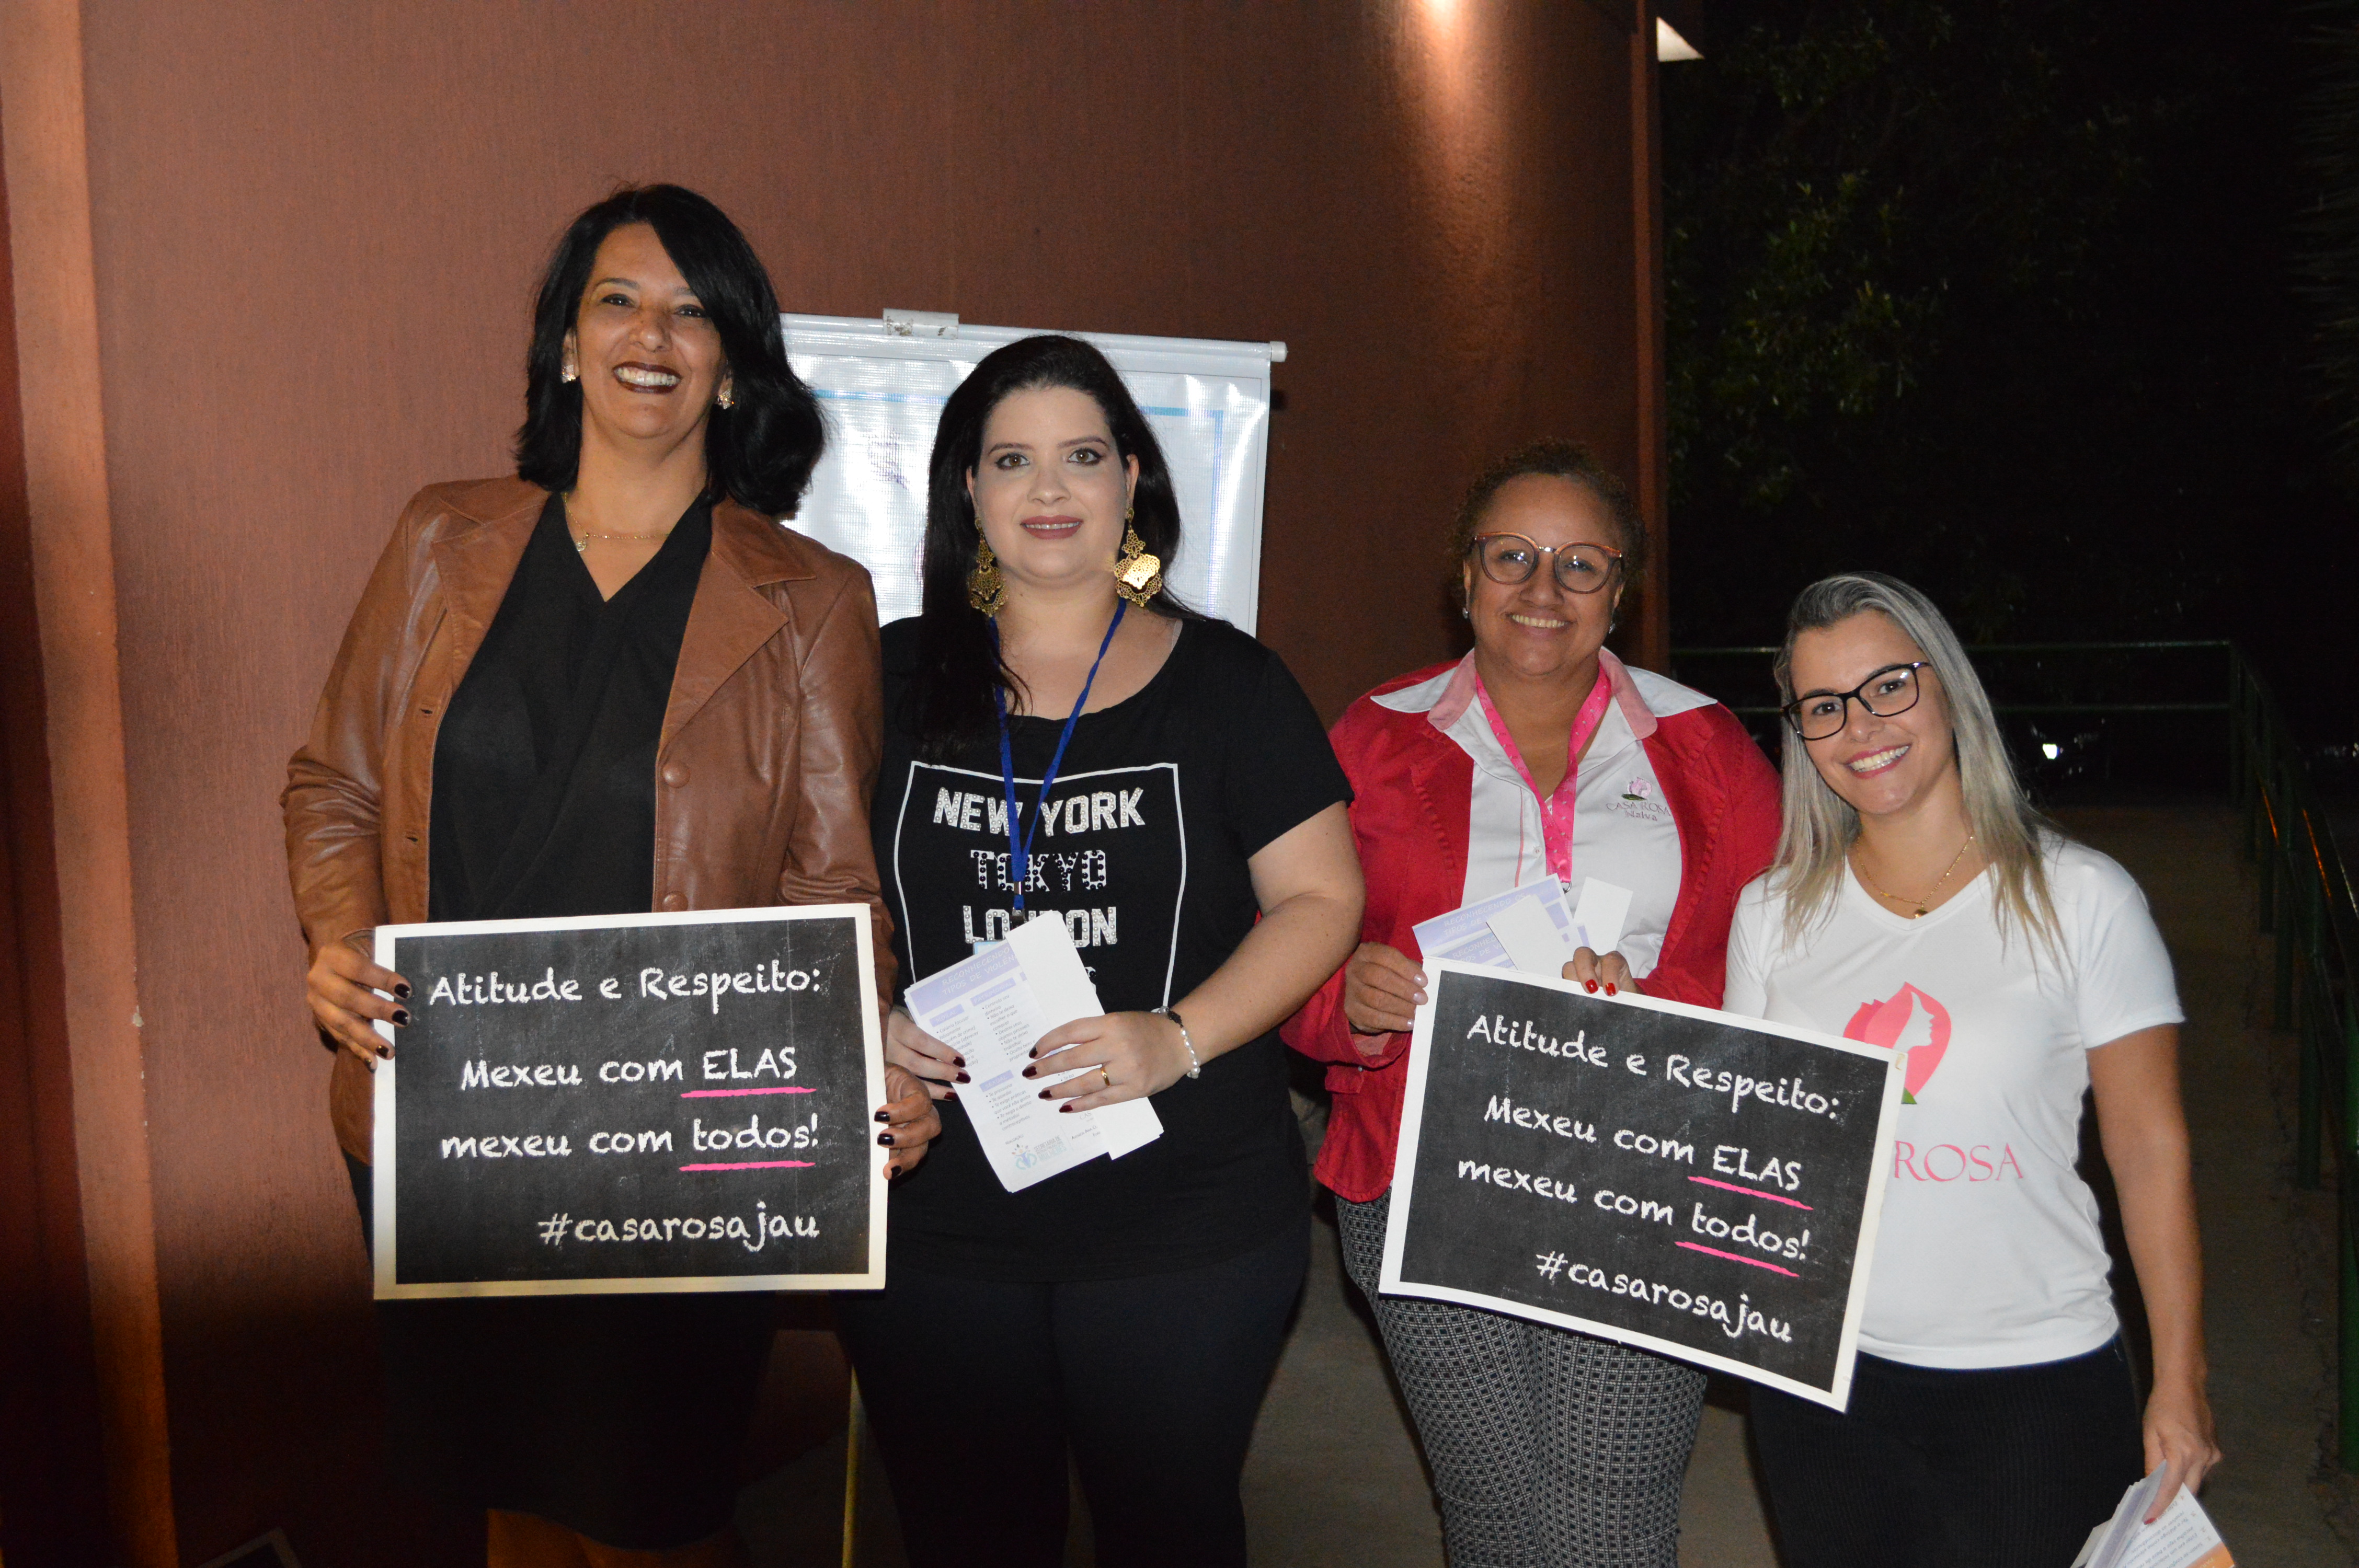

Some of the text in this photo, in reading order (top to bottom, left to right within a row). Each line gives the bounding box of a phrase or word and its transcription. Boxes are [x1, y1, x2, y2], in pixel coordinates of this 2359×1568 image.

[933, 787, 1146, 837] NEW YORK
[1606, 801, 1671, 816] CASA ROSA
[970, 849, 1107, 892] TOKYO
[963, 906, 1117, 948] LOON
[1444, 897, 1510, 927] RECONHECENDO
[1444, 923, 1467, 936] TIPOS
[941, 947, 1010, 986] RECONHECENDO
[1452, 935, 1496, 958] RECONHEC
[1478, 947, 1491, 956] DE
[429, 959, 820, 1015] Atitude e Respeito:
[942, 952, 1016, 996] TIPOS DE VIOLÊN
[461, 1046, 797, 1091] Mexeu com ELAS
[1467, 1014, 1840, 1119] Atitude e Respeito:
[441, 1112, 818, 1159] mexeu com todos!
[1484, 1095, 1802, 1191] Mexeu com ELAS
[1894, 1140, 2023, 1182] ROSA
[538, 1201, 820, 1252] #casarosajau
[1458, 1160, 1810, 1260] mexeu com todos!
[1536, 1251, 1793, 1343] #casarosajau
